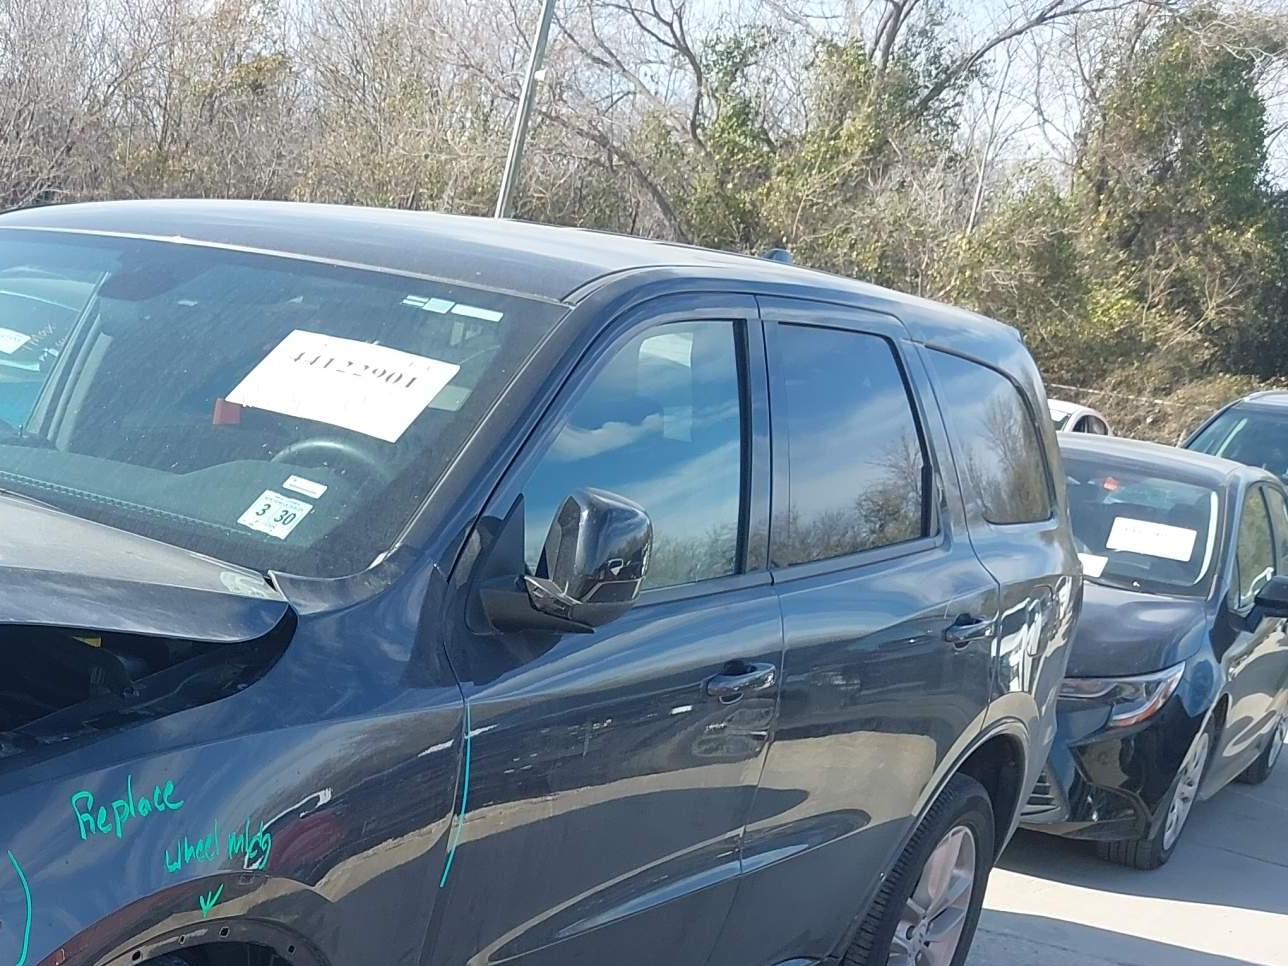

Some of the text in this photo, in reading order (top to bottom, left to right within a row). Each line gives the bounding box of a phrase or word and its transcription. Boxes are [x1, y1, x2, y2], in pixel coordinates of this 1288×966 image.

[255, 503, 271, 517] 3
[273, 509, 297, 526] 30
[72, 774, 184, 840] Replace
